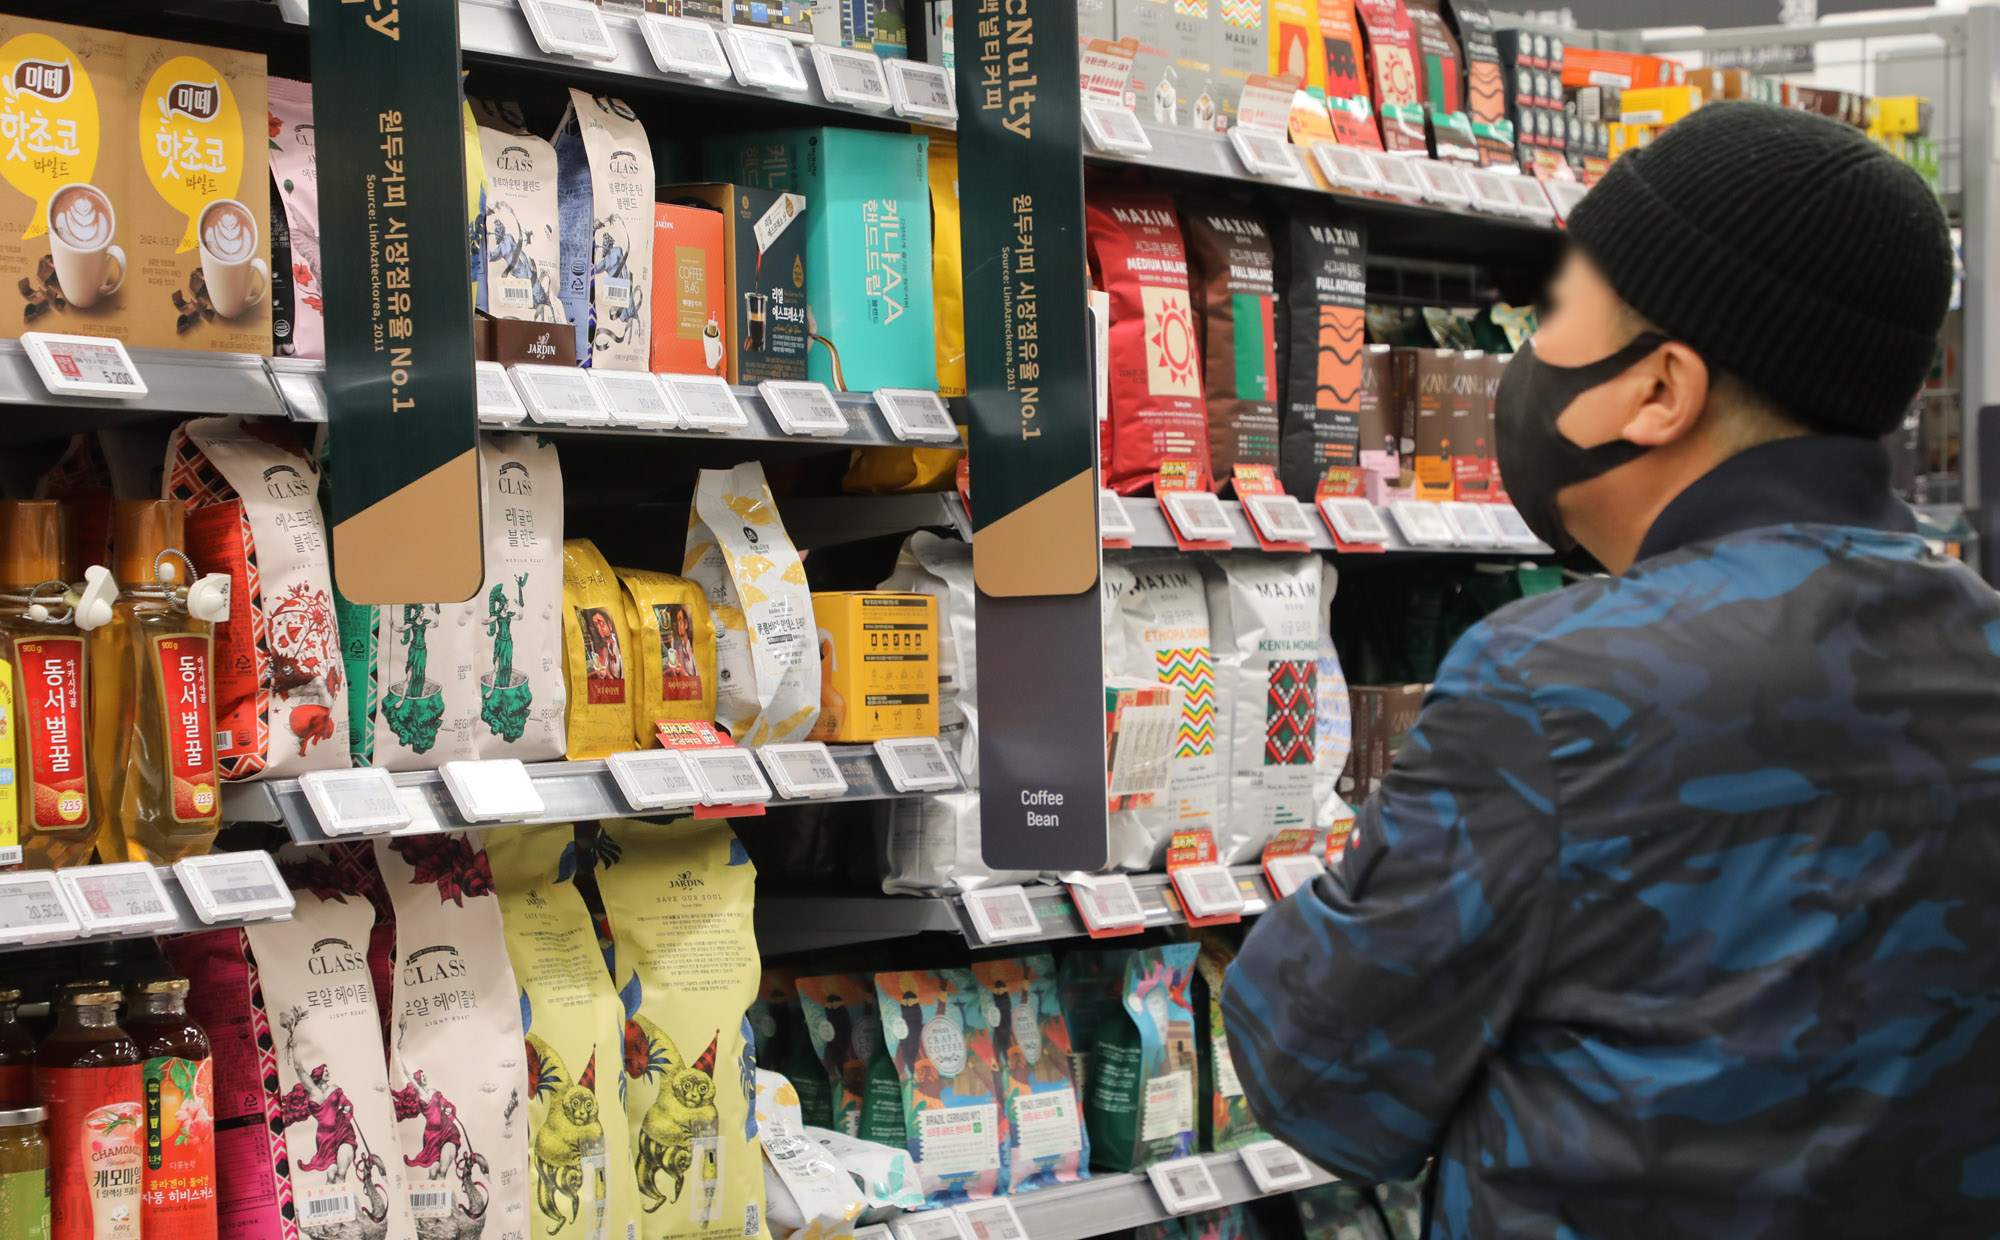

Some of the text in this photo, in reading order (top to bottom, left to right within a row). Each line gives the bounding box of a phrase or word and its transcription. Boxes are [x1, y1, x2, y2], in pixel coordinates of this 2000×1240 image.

[1225, 32, 1258, 46] MAXIM
[25, 65, 63, 95] 미떼
[863, 78, 882, 93] 4,780
[178, 87, 211, 115] 미떼
[0, 105, 80, 162] 핫초코
[155, 124, 227, 180] 핫초코
[34, 157, 70, 179] 마일드
[496, 156, 533, 173] CLASS
[609, 161, 639, 175] CLASS
[186, 174, 217, 195] 마일드
[522, 178, 542, 193] 블렌드
[608, 182, 643, 197] 블루마운틴
[616, 197, 638, 211] 블렌드
[656, 220, 673, 230] JARDIN
[1112, 207, 1175, 228] MAXIM
[1207, 216, 1264, 237] MAXIM
[1309, 225, 1360, 248] MAXIM
[863, 199, 882, 296] 핸드드립
[366, 174, 384, 353] Source: LinkAzteckorea, 2011
[379, 110, 415, 413] 원두커피 시장점유율 No.1
[880, 198, 904, 326] 케냐AA
[1126, 257, 1161, 271] MEDIUM
[678, 265, 704, 282] COFFEE
[1229, 265, 1247, 280] FULL
[684, 280, 700, 295] BAG
[1315, 276, 1336, 291] FULL
[771, 287, 783, 304] 리얼
[1001, 246, 1010, 285] Source:
[1007, 367, 1016, 392] 2011
[1012, 194, 1042, 440] 원두커피 시장점유율 No.1
[526, 343, 556, 356] JARDIN
[1452, 372, 1484, 396] KANU
[267, 479, 311, 500] CLASS
[498, 477, 533, 497] CLASS
[505, 507, 534, 528] 레귤러
[293, 531, 321, 554] 블렌드
[507, 528, 539, 548] 블렌드
[1130, 573, 1192, 595] MAXIM
[1256, 582, 1318, 599] MAXIM
[22, 644, 37, 653] 900
[161, 641, 173, 650] 900
[1258, 639, 1292, 652] KENYA
[66, 658, 78, 709] 아카시아꿀
[197, 656, 207, 704] 아카시아꿀
[42, 658, 72, 773] 동서벌꿀
[178, 656, 204, 767] 동서벌꿀
[1021, 790, 1064, 805] Coffee
[1027, 811, 1059, 827] Bean
[669, 879, 704, 889] JARDIN
[308, 952, 365, 976] CLASS
[403, 959, 467, 987] CLASS
[307, 987, 333, 1009] 로얄
[432, 990, 478, 1012] 헤이즐넛
[329, 1009, 367, 1020] LIGHT ROAST
[425, 1014, 470, 1027] LIGHT ROAST
[926, 1033, 958, 1045] CRAFT
[926, 1114, 945, 1126] BRAZIL
[946, 1111, 970, 1124] CERRADO
[149, 1178, 186, 1191] 콜라겐이
[142, 1187, 214, 1205] 자몽 히비스커스
